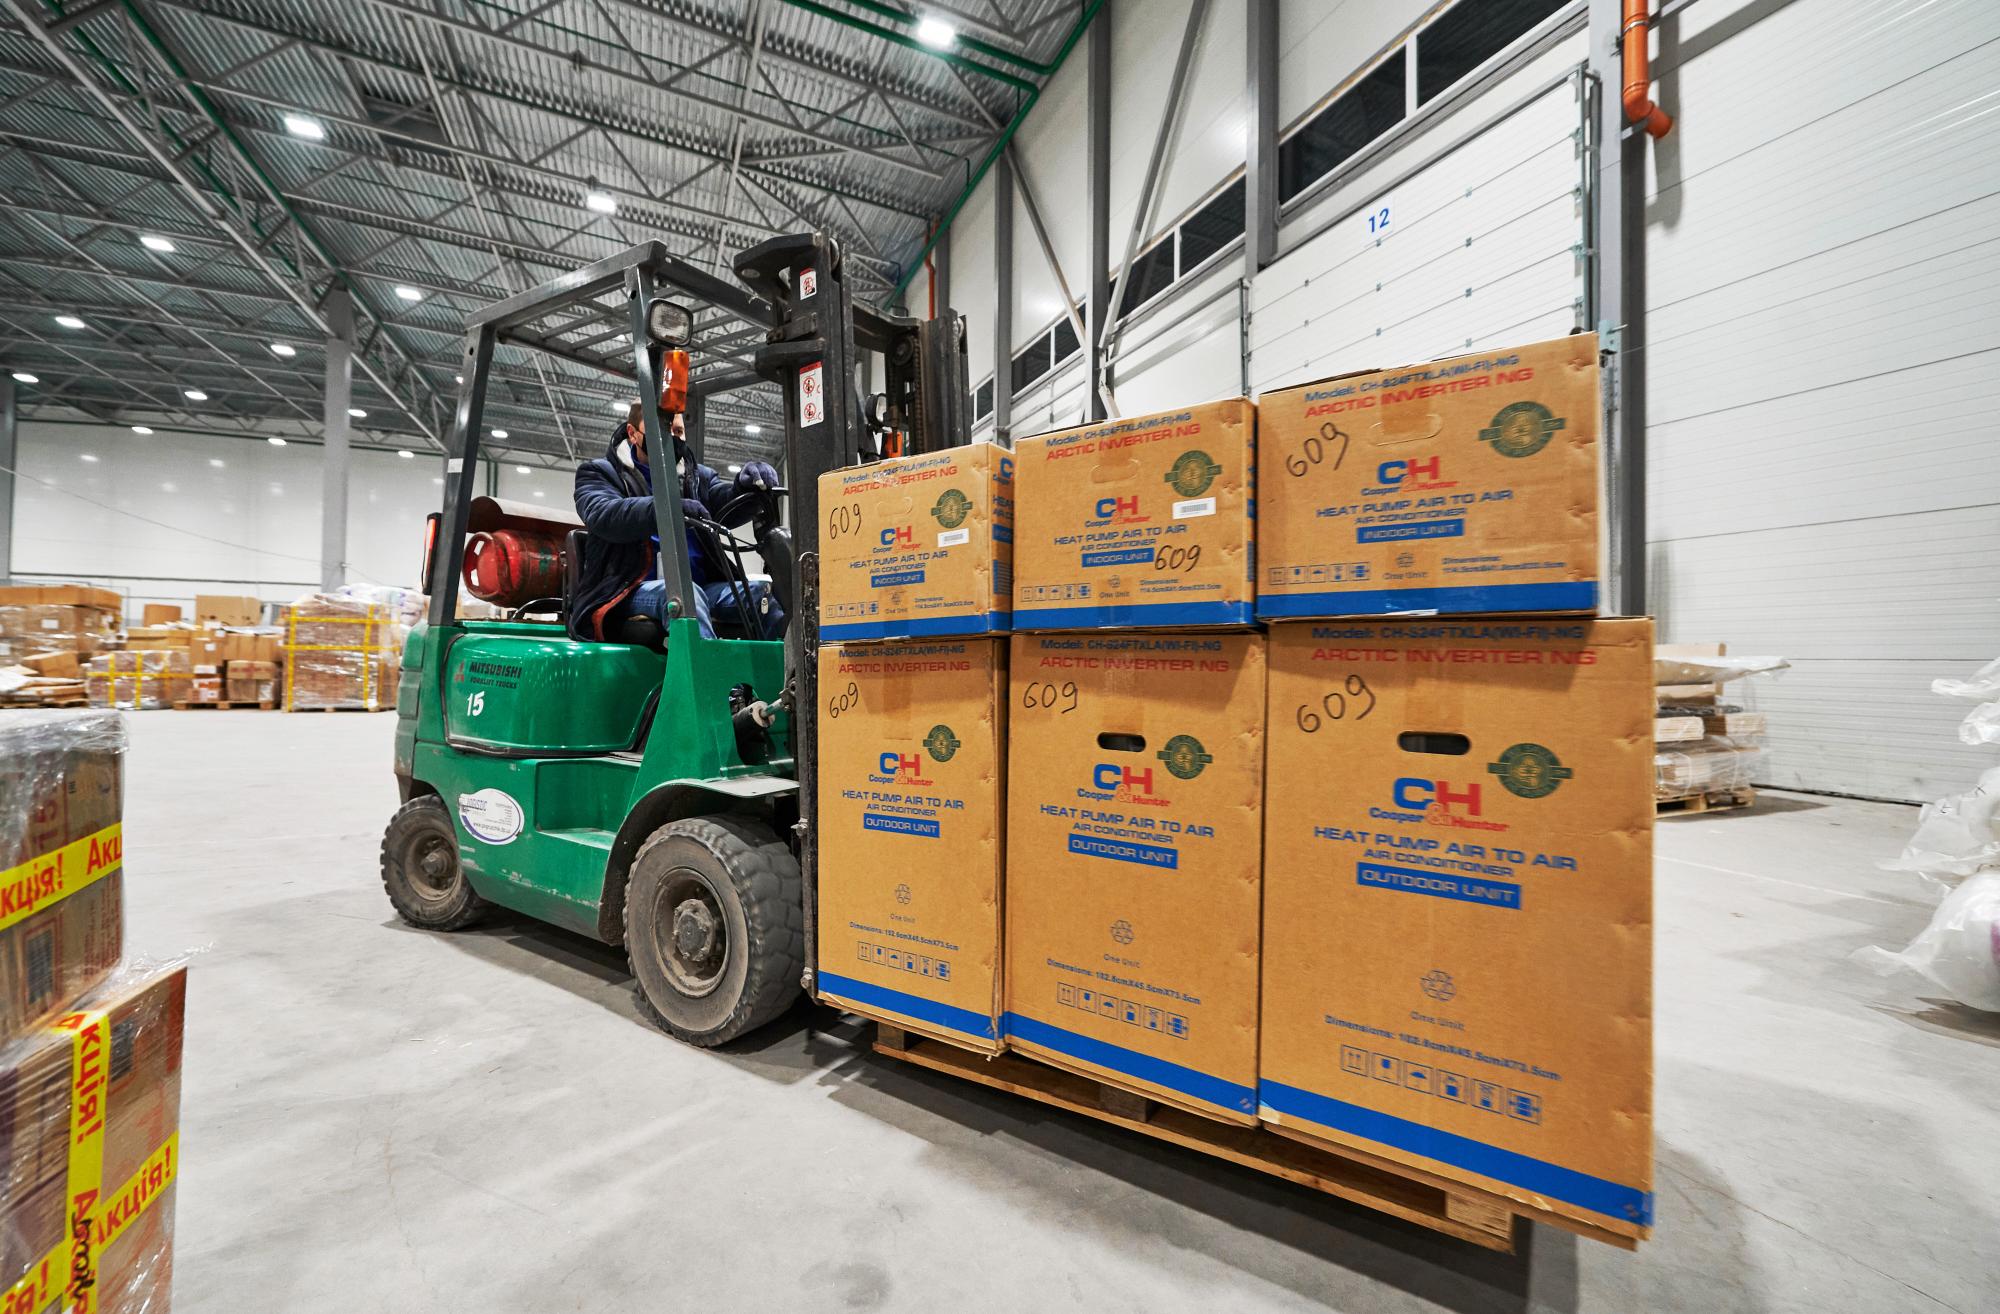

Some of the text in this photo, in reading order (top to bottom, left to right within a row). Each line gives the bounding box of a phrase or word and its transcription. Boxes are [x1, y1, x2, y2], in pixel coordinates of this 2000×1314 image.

[1369, 208, 1390, 233] 12
[1304, 367, 1534, 418] ARCTIC INVERTER NG
[1304, 384, 1356, 402] Model:
[1046, 436, 1080, 447] Model:
[1046, 423, 1200, 461] ARCTIC INVERTER NG
[1286, 422, 1349, 477] 609
[843, 482, 879, 496] ARCTIC
[940, 465, 958, 477] NG
[1377, 455, 1440, 485] CH
[1095, 495, 1138, 518] CH
[1316, 489, 1513, 518] HEAT PUMP AIR TO AIR
[829, 503, 862, 540] 609
[1354, 507, 1467, 525] AIR CONDITIONER
[880, 525, 912, 545] CH
[1054, 524, 1188, 545] HEAT PUMP AIR TO AIR
[1363, 523, 1456, 540] INDOOR UNIT
[1096, 539, 1156, 550] CONDITIONER
[850, 550, 948, 569] HEAT PUMP AIR TO AIR
[881, 562, 926, 573] CONDITIONER
[1086, 552, 1149, 564] INDOOR UNIT
[1154, 544, 1201, 572] 609
[874, 574, 922, 585] INDOOR UNIT
[1312, 626, 1371, 639] Model:
[839, 649, 868, 657] Model:
[1040, 639, 1083, 649] Model:
[839, 661, 970, 673] ARCTIC INVERTER NG
[1040, 657, 1229, 672] ARCTIC INVERTER NG
[1311, 648, 1597, 665] ARCTIC INVERTER NG
[469, 662, 522, 678] MITSUBISHI
[467, 691, 485, 717] 15
[829, 682, 858, 719] 609
[1023, 681, 1078, 714] 609
[1296, 674, 1376, 733] 609
[880, 752, 920, 776] CH
[1093, 763, 1153, 795] CH
[842, 790, 964, 810] HEAT PUMP AIR TO AIR
[1077, 788, 1115, 801] Cooper
[1132, 795, 1171, 807] Hunter
[1393, 777, 1481, 816] CH
[867, 803, 936, 817] AIR CONDITIONER
[1040, 804, 1214, 838] HEAT PUMP AIR TO AIR
[1369, 807, 1425, 824] Cooper
[1451, 816, 1510, 832] Hunter
[866, 817, 937, 833] OUTDOOR UNIT
[1072, 821, 1173, 843] AIR CONDITIONER
[1071, 839, 1174, 864] OUTDOOR UNIT
[1314, 826, 1577, 871] HEAT PUMP AIR TO AIR
[1363, 848, 1515, 877] AIR CONDITIONER
[1361, 868, 1515, 901] OUTDOOR UNIT
